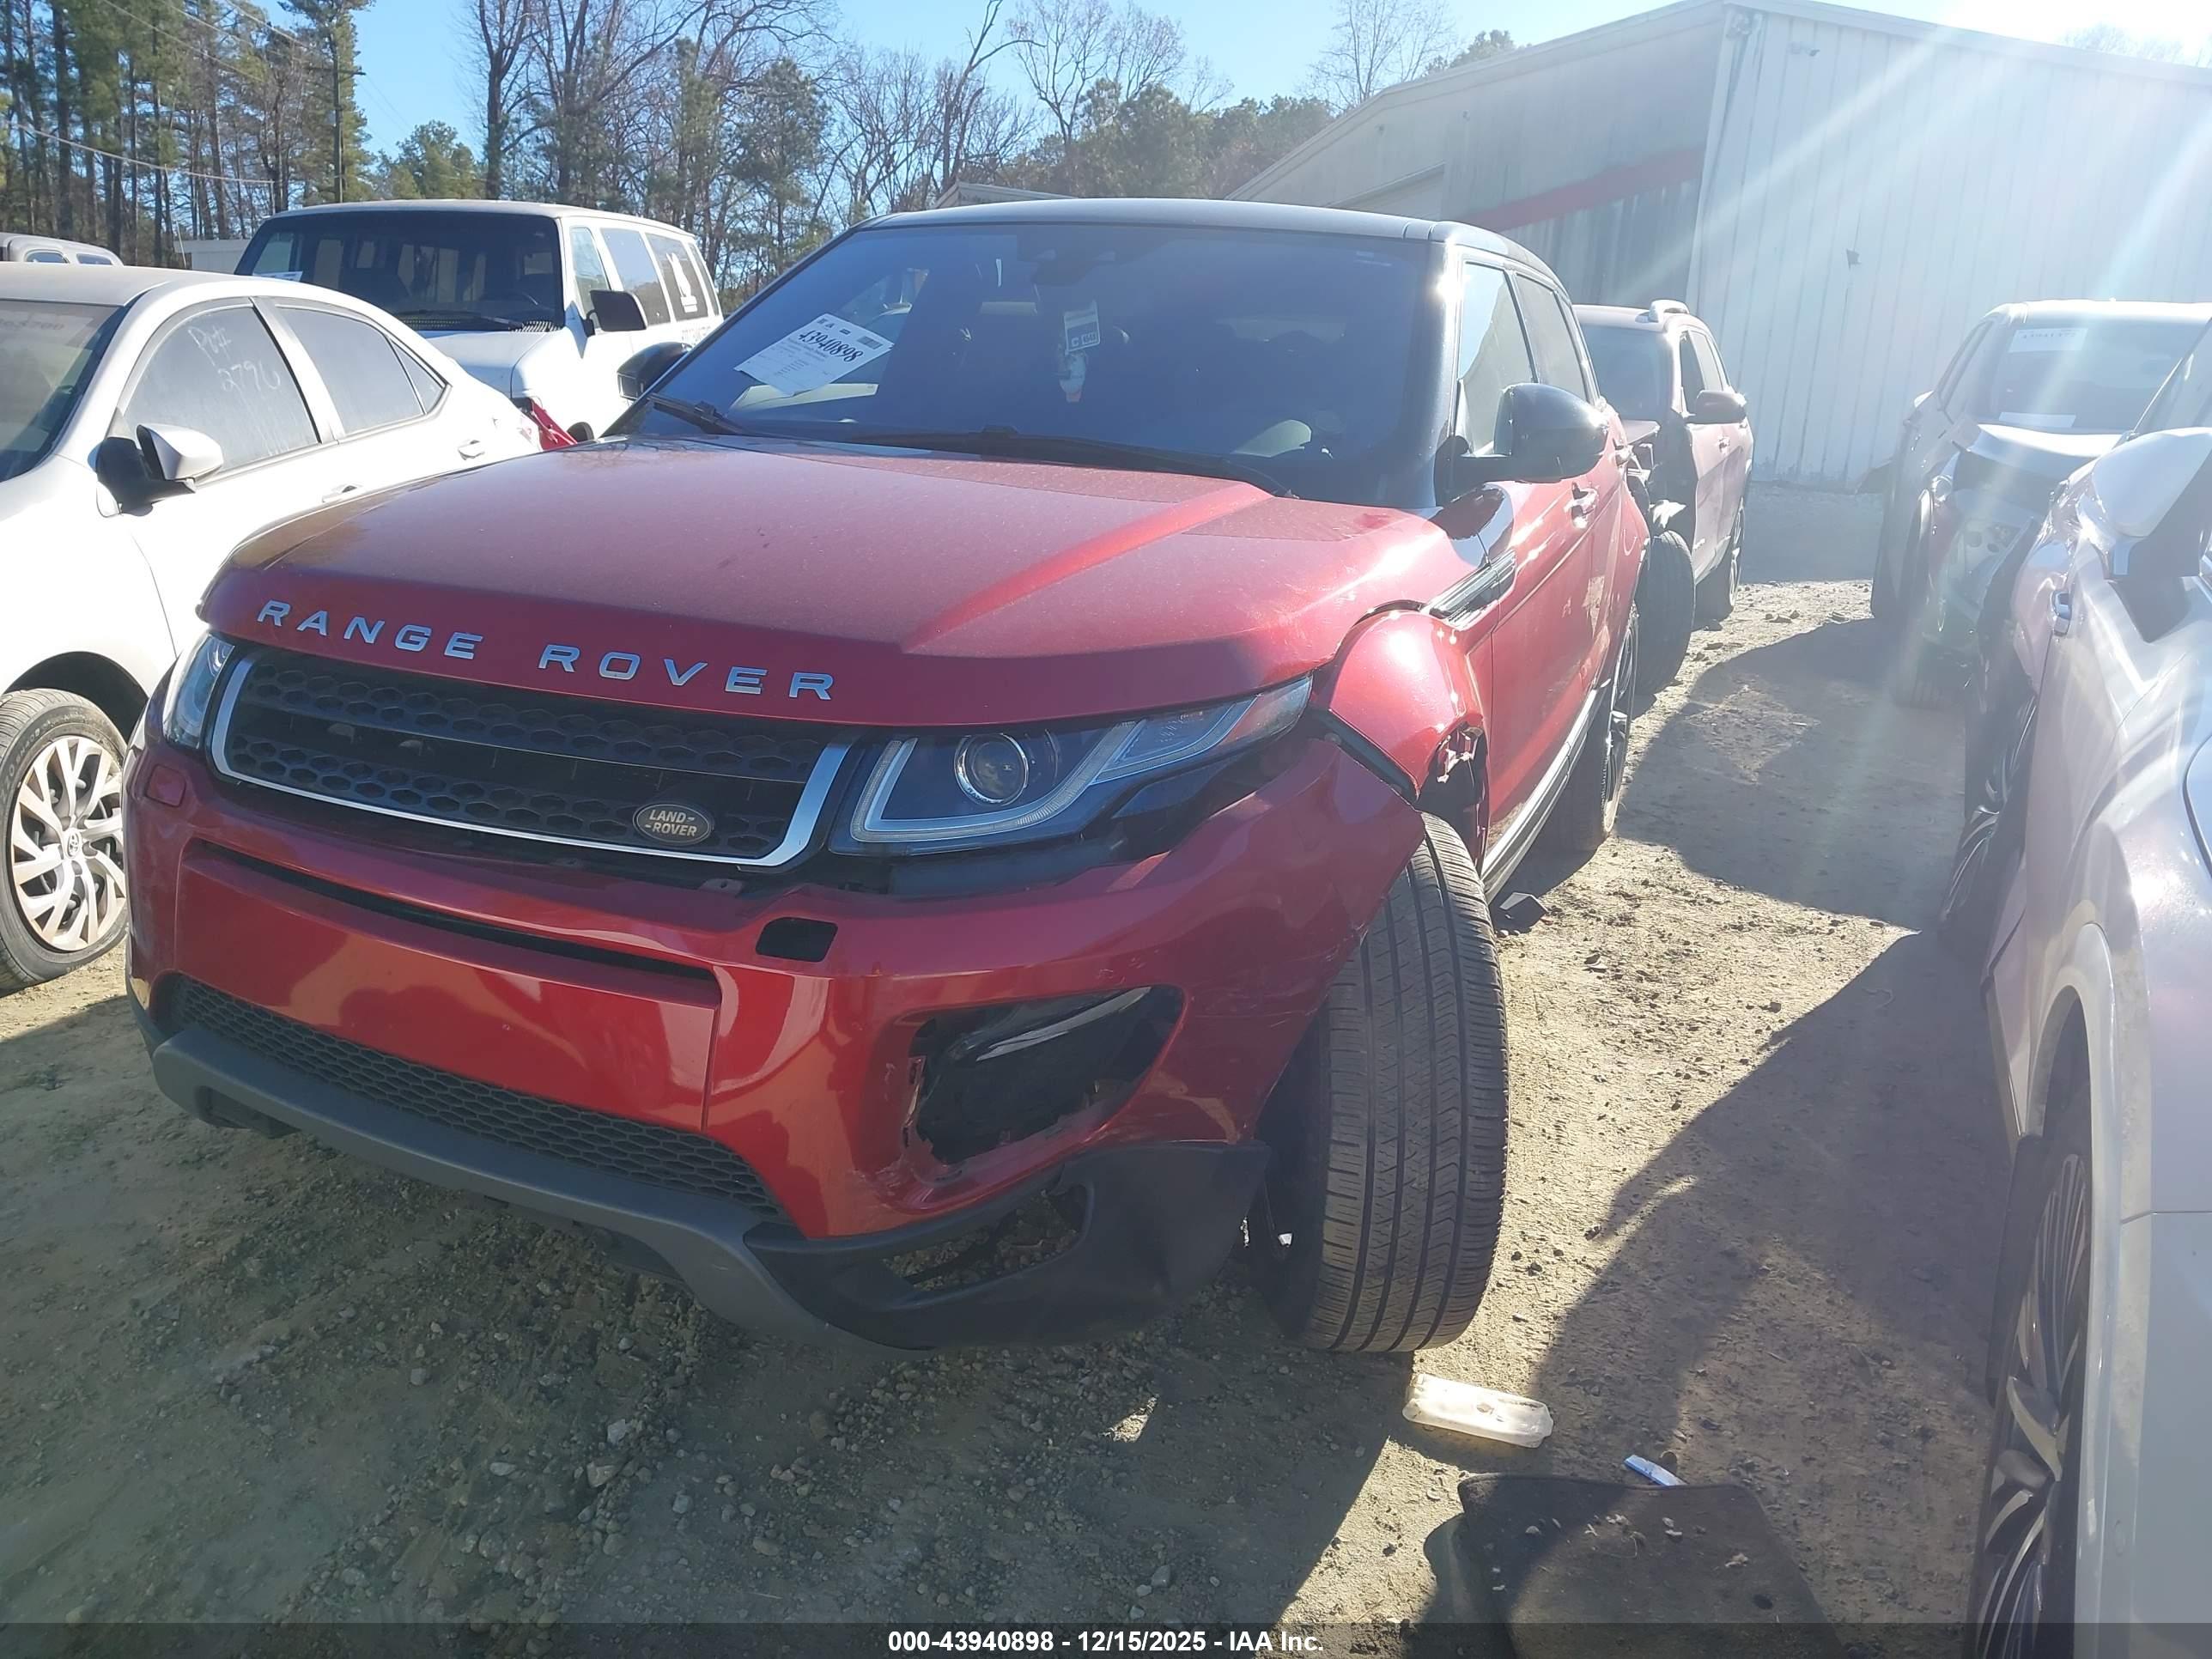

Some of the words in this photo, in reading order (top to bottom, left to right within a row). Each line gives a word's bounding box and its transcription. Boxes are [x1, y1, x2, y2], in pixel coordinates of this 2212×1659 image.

[797, 329, 865, 363] 43940898
[257, 599, 483, 659] RANGE
[538, 644, 836, 702] ROVER
